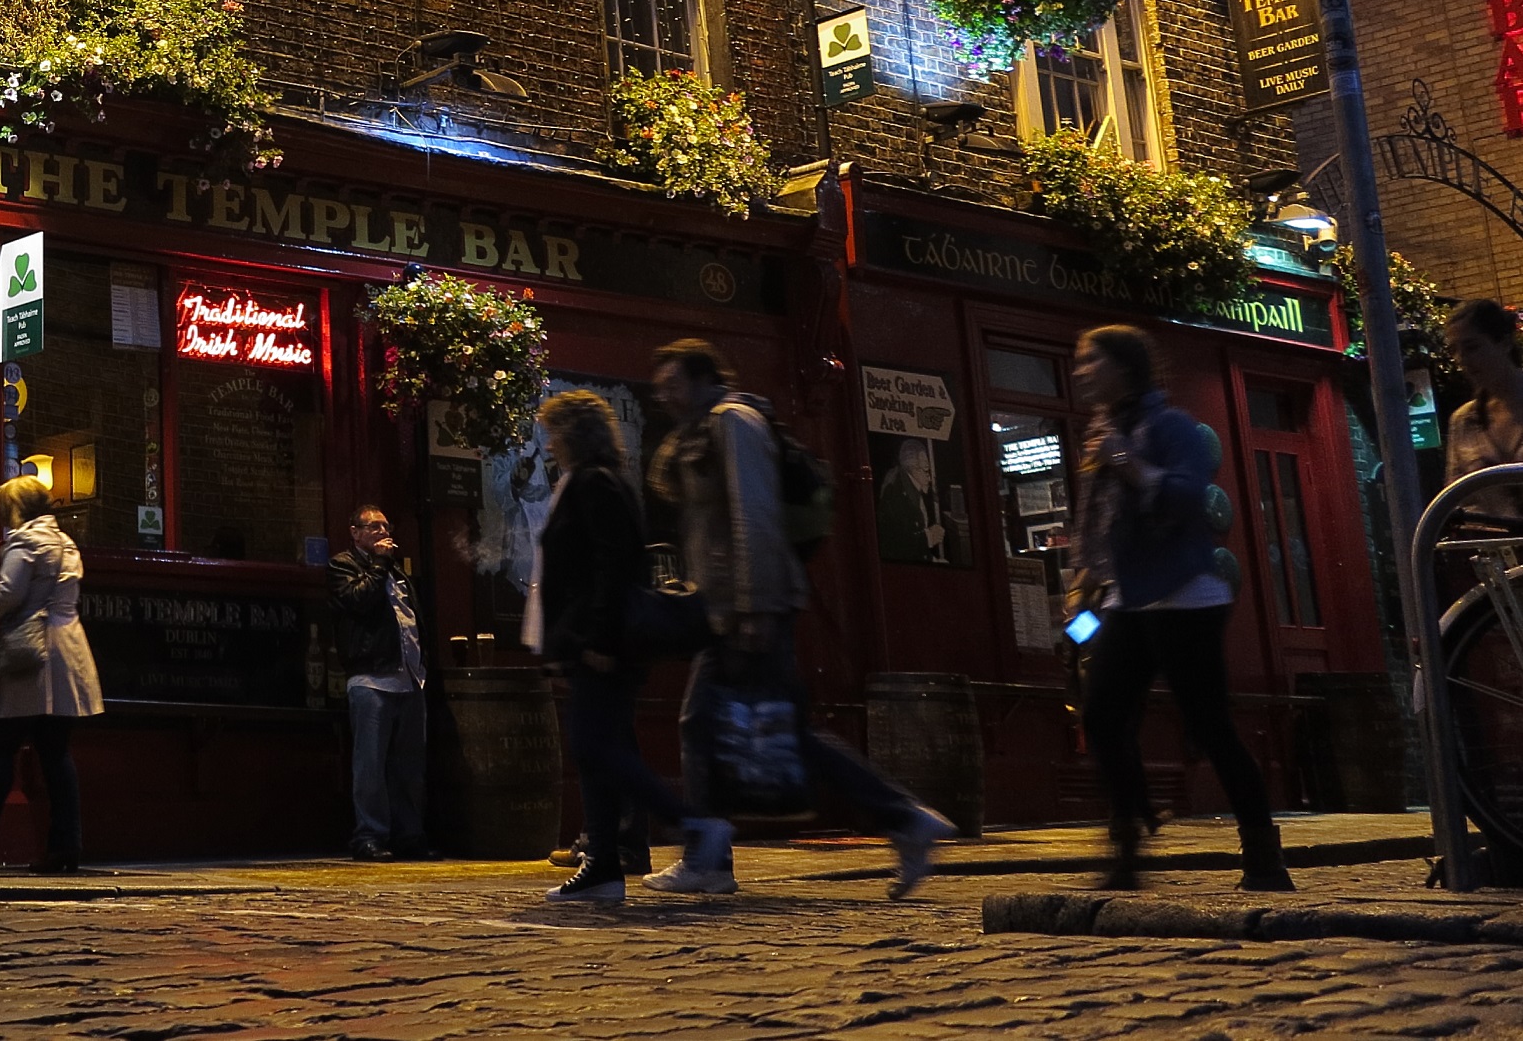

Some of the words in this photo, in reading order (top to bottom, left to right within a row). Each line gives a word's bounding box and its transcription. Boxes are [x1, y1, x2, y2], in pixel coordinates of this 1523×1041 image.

[1258, 4, 1299, 28] BAR
[1248, 46, 1275, 61] BEER
[1277, 33, 1319, 53] GARDEN
[1259, 75, 1284, 89] LIVE
[1285, 65, 1319, 82] MUSIC
[1276, 79, 1305, 95] DAILY
[157, 172, 430, 257] TEMPLE
[460, 221, 582, 281] BAR
[184, 295, 305, 328] Traditional
[182, 325, 238, 355] Irish
[248, 333, 312, 364] Music
[208, 378, 263, 403] TEMPLE
[269, 386, 294, 413] BAR
[865, 371, 891, 391] Beer
[895, 376, 935, 397] Garden
[868, 392, 915, 417] Smoking
[880, 414, 906, 432] Area
[139, 597, 241, 629] TEMPLE
[249, 605, 299, 632] BAR
[166, 629, 217, 643] DUBLIN
